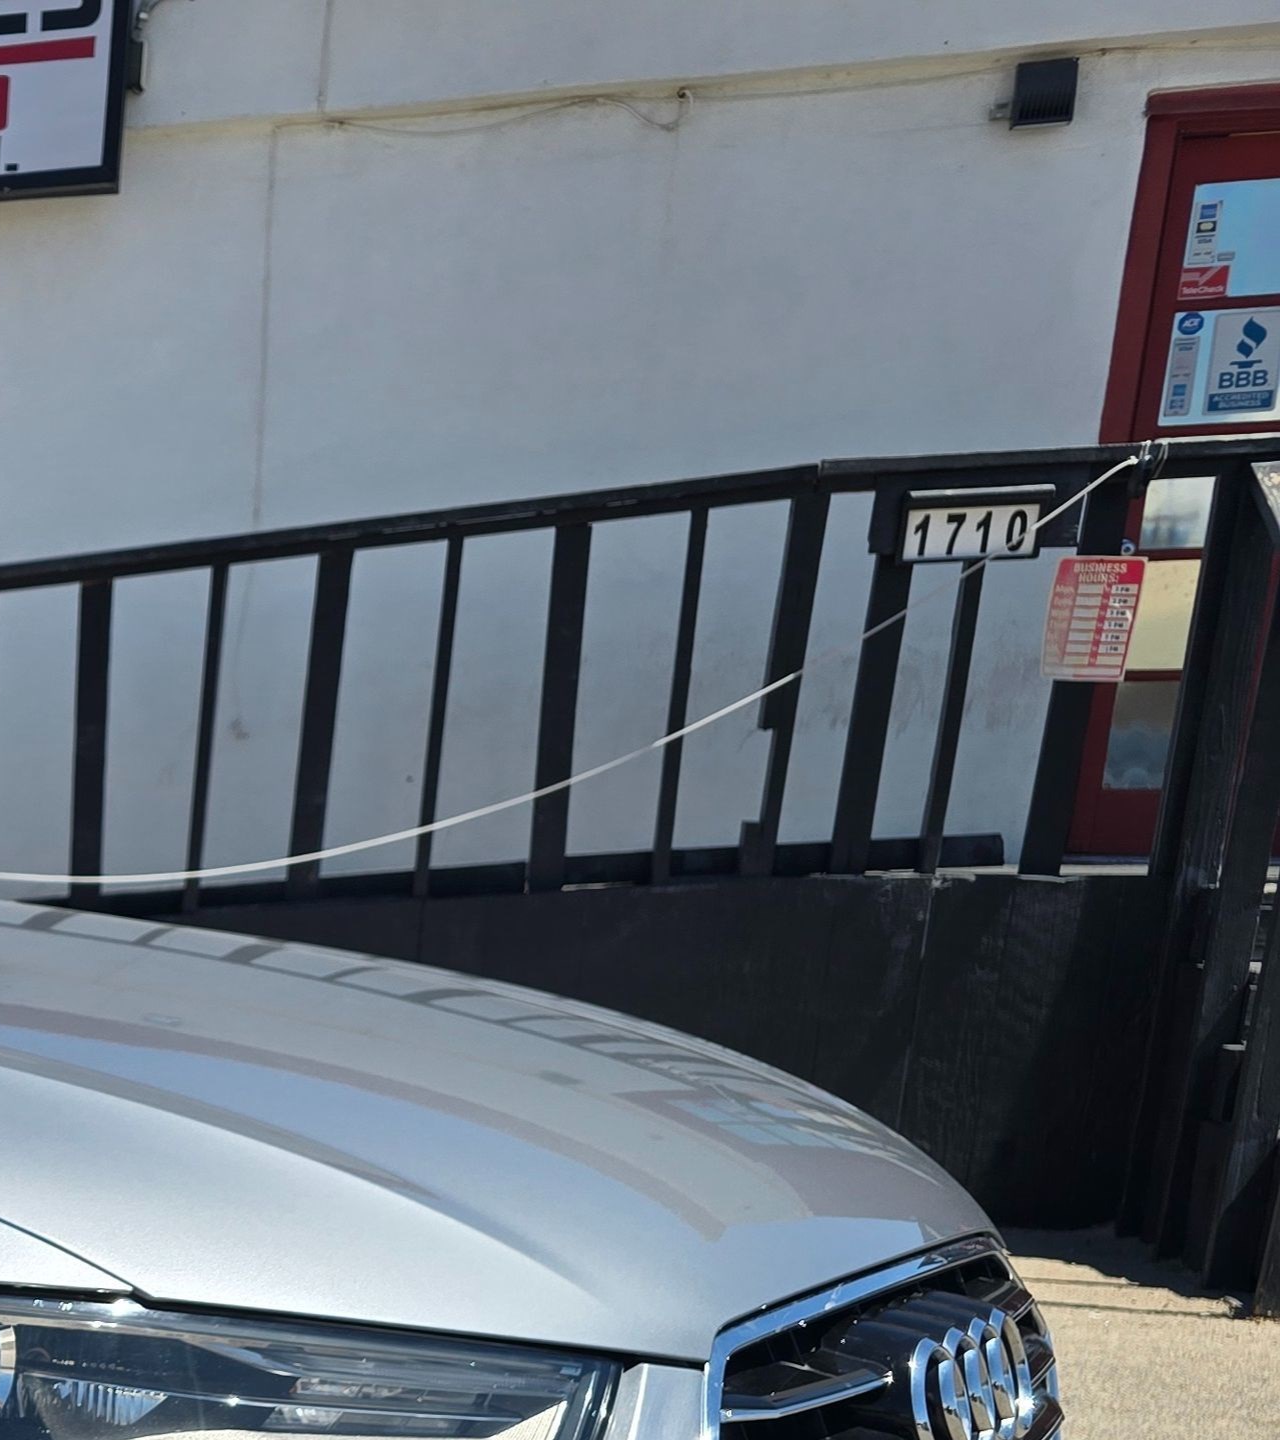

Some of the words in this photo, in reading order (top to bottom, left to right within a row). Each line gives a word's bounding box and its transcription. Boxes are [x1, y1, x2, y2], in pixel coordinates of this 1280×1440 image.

[1218, 369, 1269, 389] BBB
[914, 508, 1028, 557] 1710
[1073, 562, 1128, 573] BUSINESS
